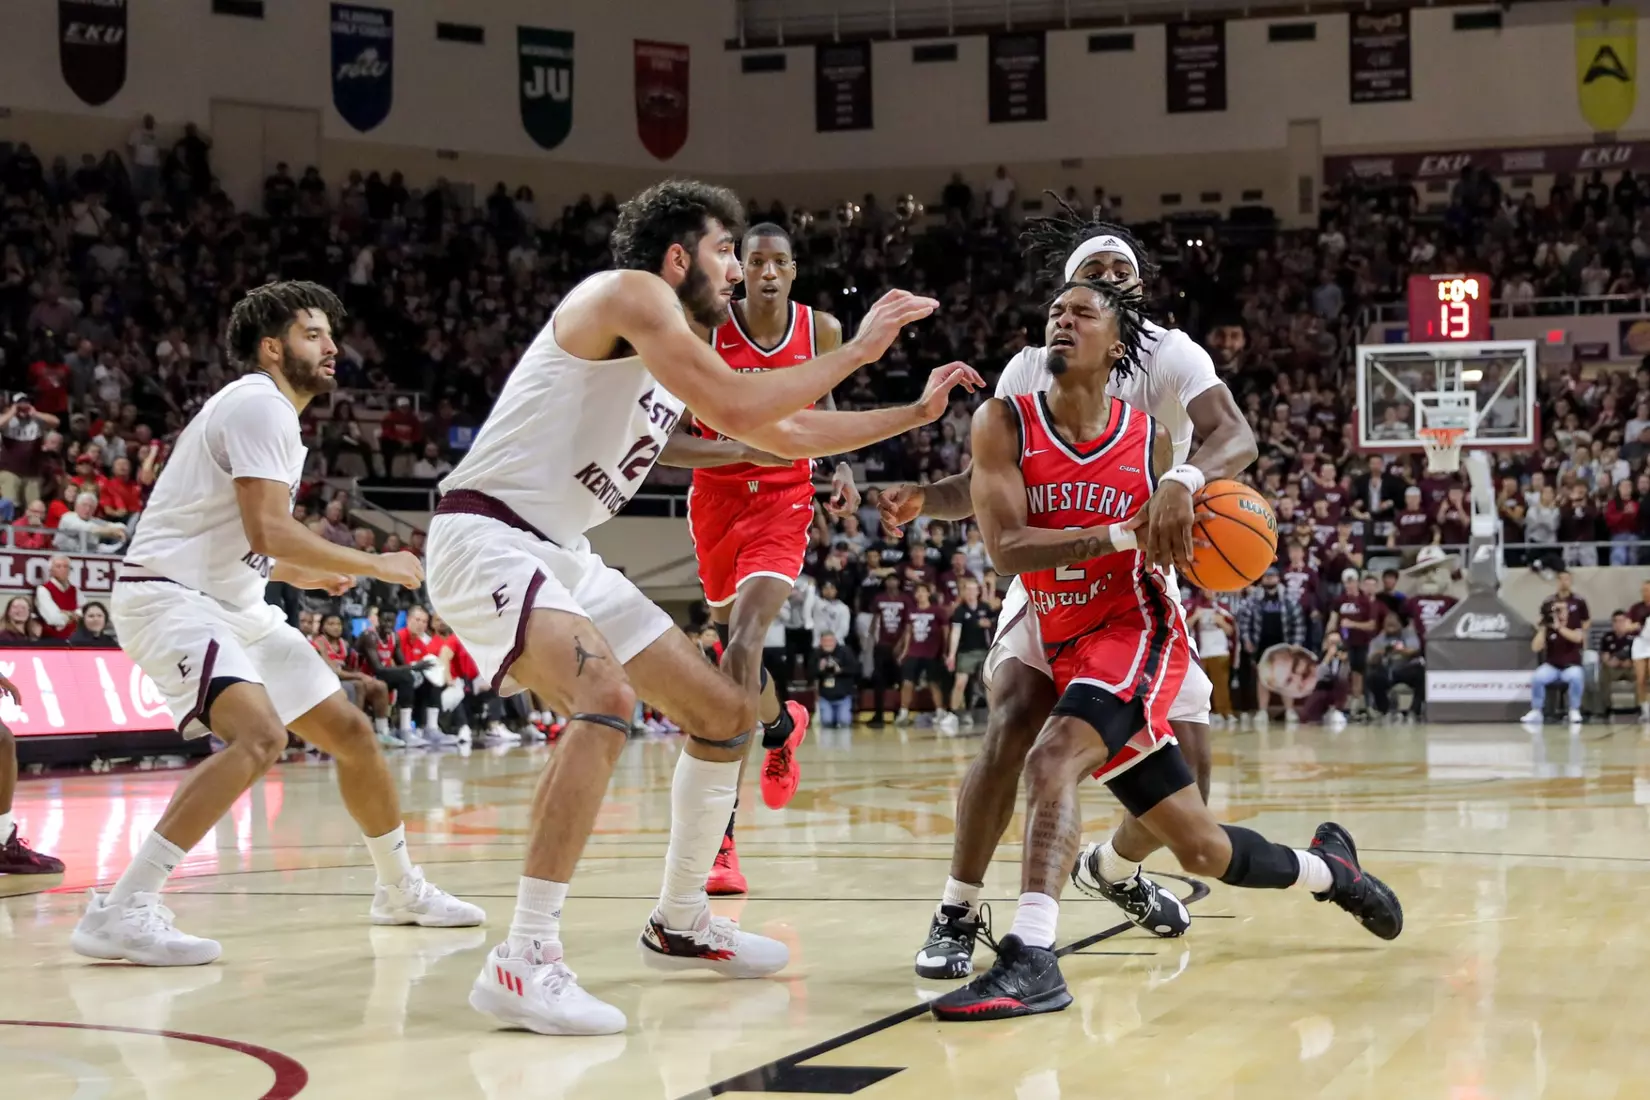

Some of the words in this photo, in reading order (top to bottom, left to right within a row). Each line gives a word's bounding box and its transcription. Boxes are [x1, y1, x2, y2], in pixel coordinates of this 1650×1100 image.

[65, 22, 124, 44] EKU
[524, 66, 570, 102] JU
[1418, 154, 1470, 176] EKU
[1578, 147, 1632, 168] EKU
[1440, 302, 1470, 338] 13
[617, 435, 661, 481] 12
[747, 480, 759, 493] W
[1026, 480, 1134, 520] WESTERN
[492, 583, 510, 613] E
[177, 655, 192, 678] E
